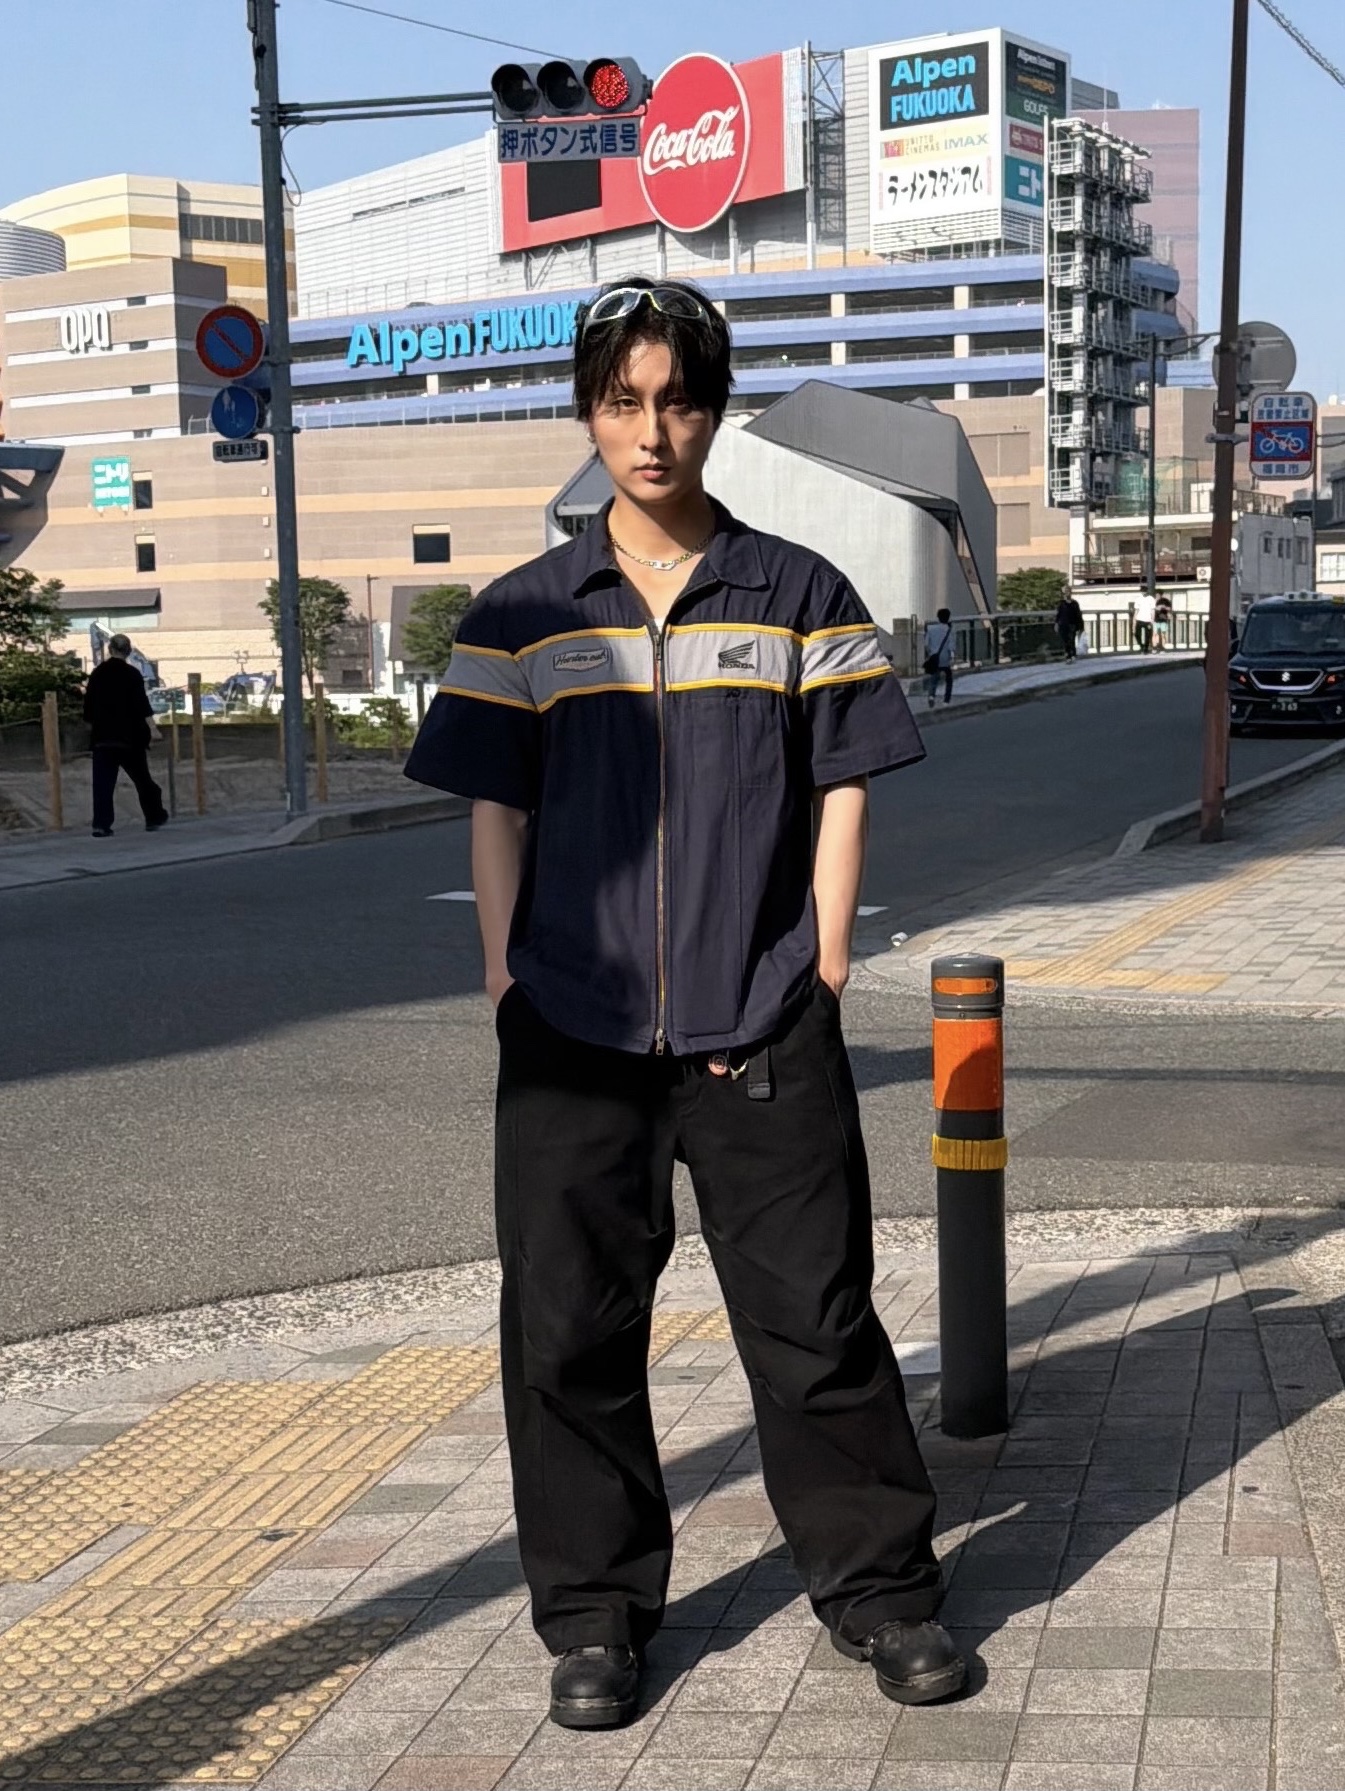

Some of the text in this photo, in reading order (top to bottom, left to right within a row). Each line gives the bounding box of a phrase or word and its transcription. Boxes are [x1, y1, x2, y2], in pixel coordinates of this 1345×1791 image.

[892, 55, 976, 88] Alpen
[891, 83, 975, 122] FUKUOKA
[501, 122, 638, 159] 押ボタン式信号
[944, 133, 989, 150] IMAX
[347, 301, 578, 374] Alpen FUKUOK
